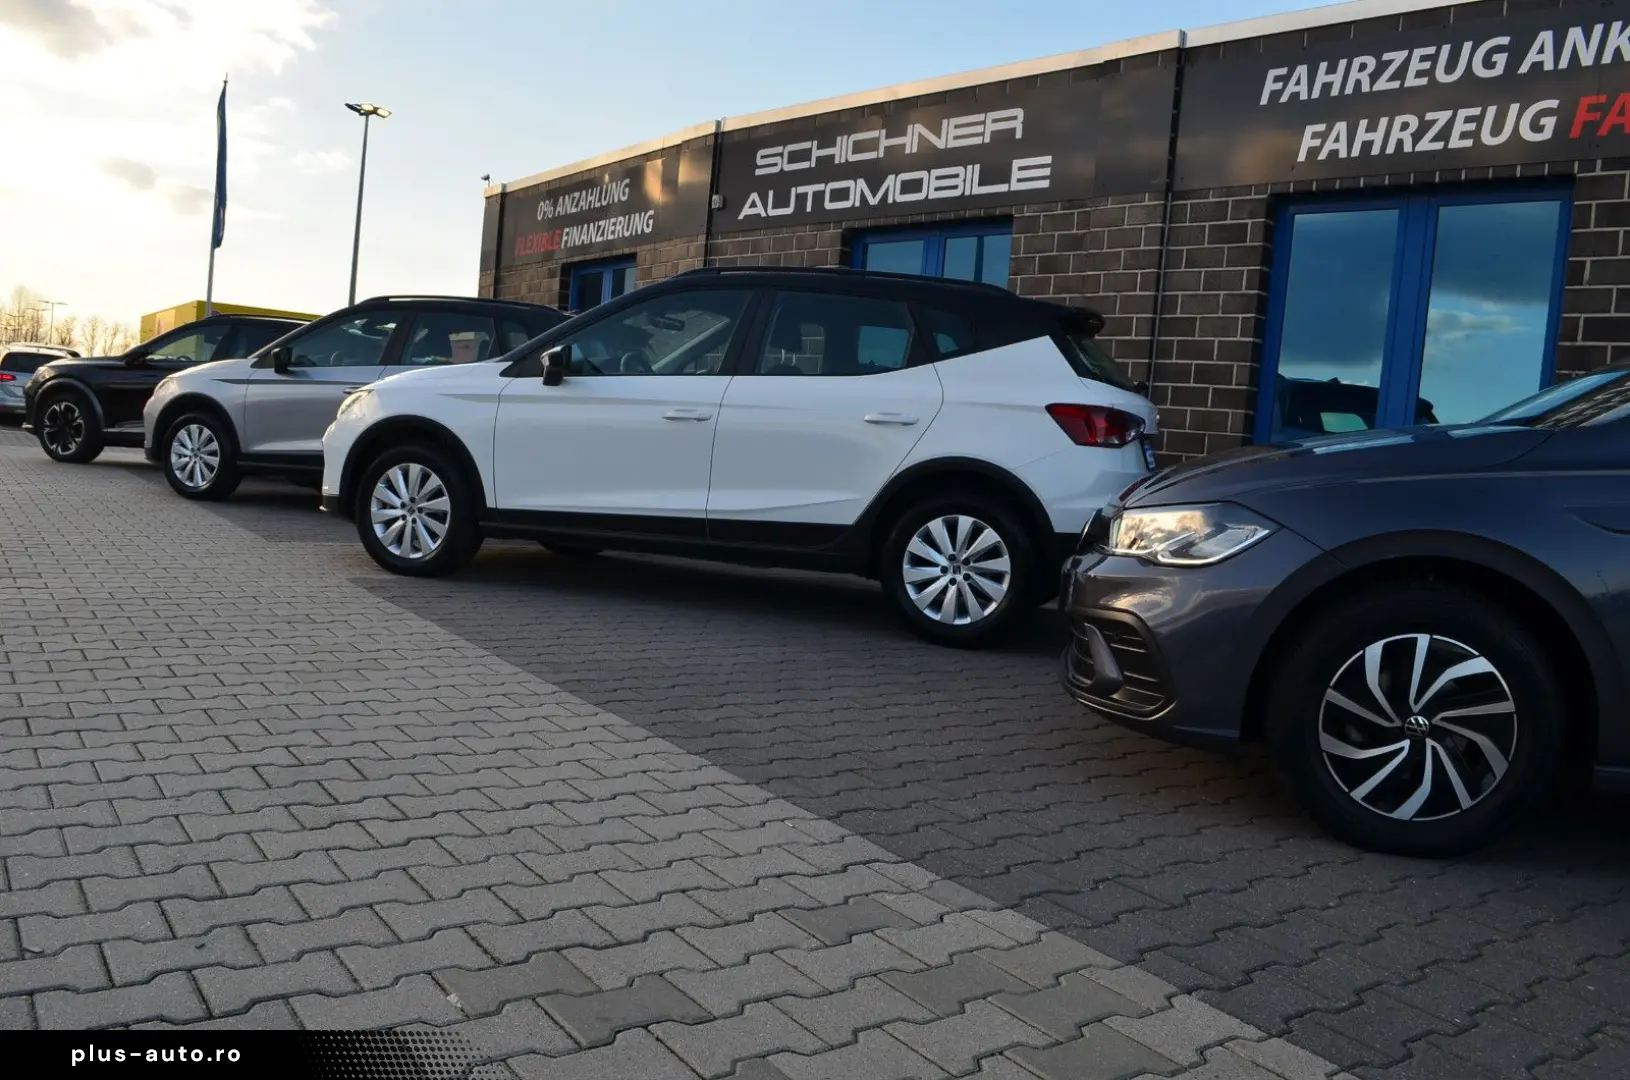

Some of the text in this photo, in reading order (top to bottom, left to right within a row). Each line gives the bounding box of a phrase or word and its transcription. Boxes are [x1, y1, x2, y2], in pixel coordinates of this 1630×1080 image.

[1259, 35, 1511, 106] FAHRZEUG
[754, 107, 1024, 176] SCHICHNER
[1296, 98, 1560, 162] FAHRZEUG
[537, 178, 631, 221] 0% ANZAHLUNG
[738, 154, 1053, 220] AUTOMOBILE
[514, 209, 655, 257] FLEXIBLE FINANZIERUNG
